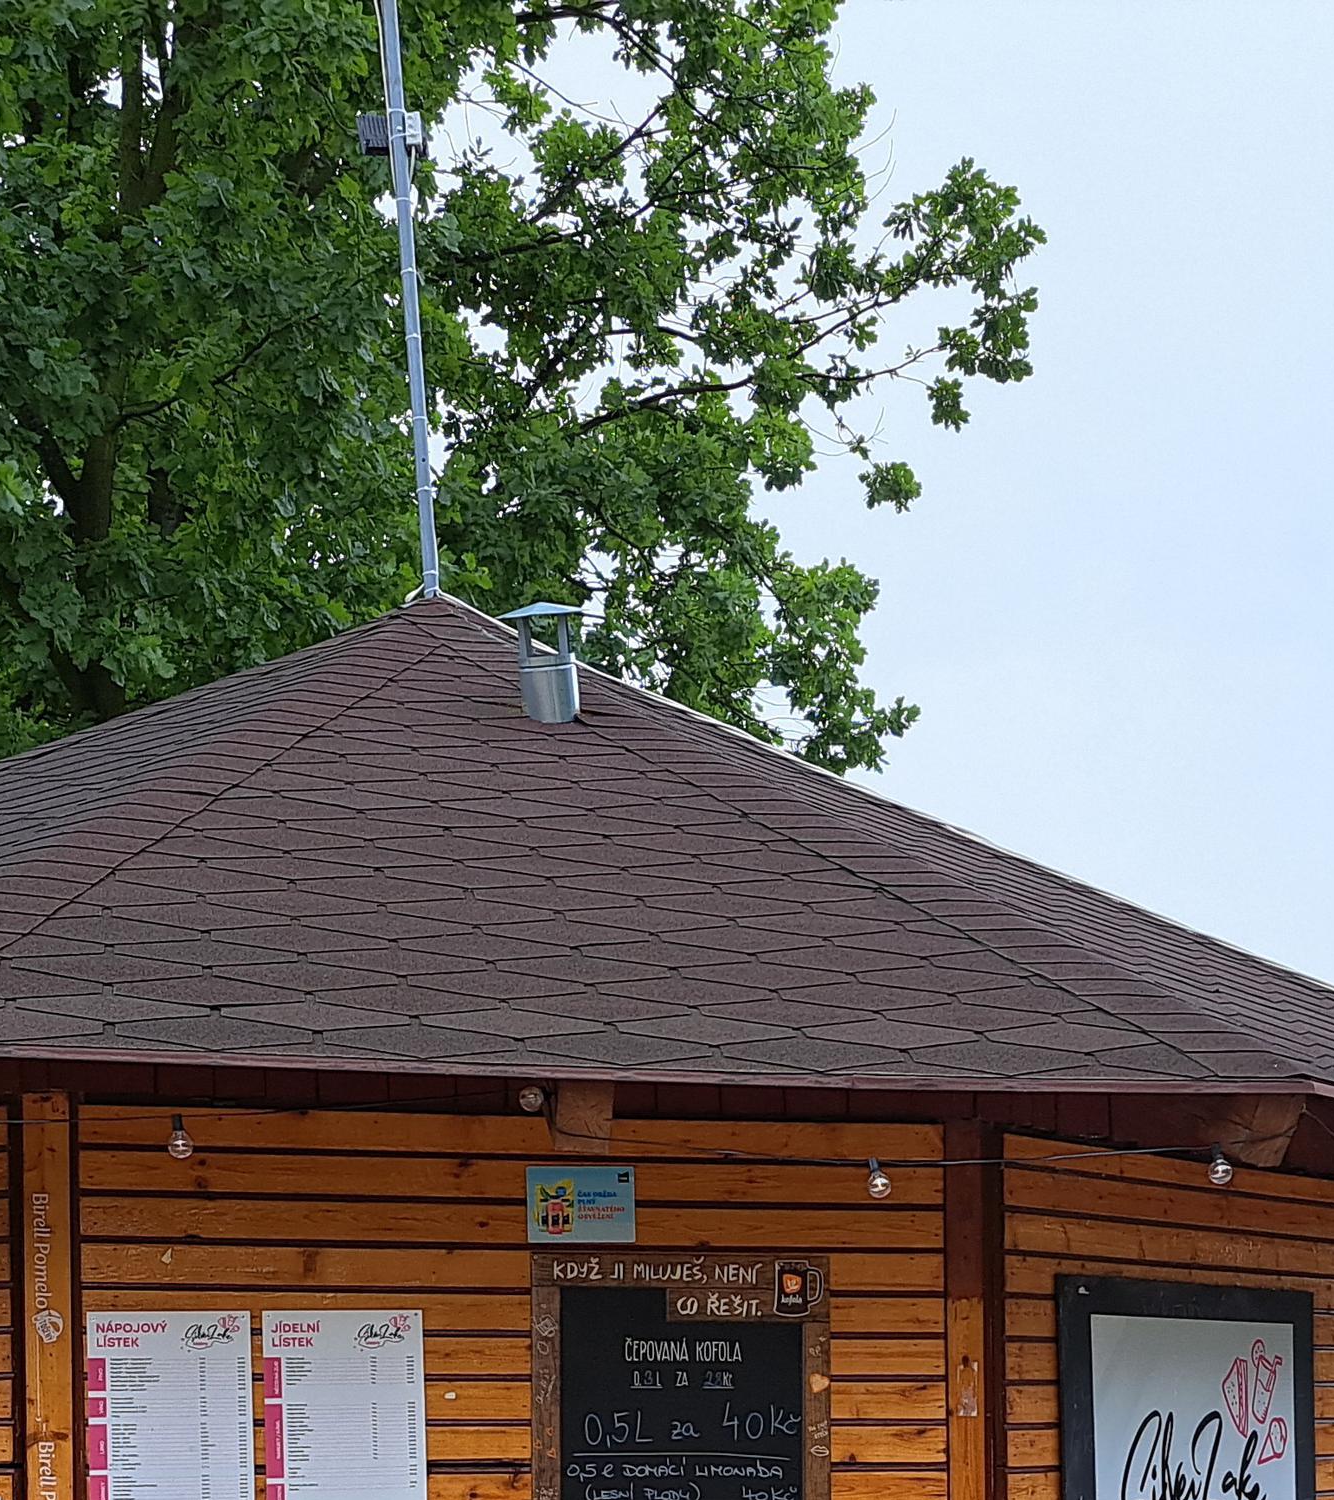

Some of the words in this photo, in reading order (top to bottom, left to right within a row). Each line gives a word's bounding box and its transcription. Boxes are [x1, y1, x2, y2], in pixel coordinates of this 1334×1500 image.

[32, 1193, 52, 1239] Birell
[33, 1243, 53, 1310] Pomelo
[553, 1257, 602, 1281] KDYŽ
[610, 1262, 624, 1280] JI
[633, 1256, 708, 1285] MILUJEŠ,
[715, 1262, 763, 1285] NENÍ
[676, 1296, 698, 1315] CO
[707, 1292, 763, 1317] ŘEŠIT.
[95, 1320, 168, 1334] NÁPOJOVÝ
[271, 1320, 321, 1334] JÍDELNÍ
[96, 1335, 140, 1348] LÍSTEK
[271, 1336, 314, 1348] LÍSTEK
[624, 1337, 689, 1362] ČEPOVANÁ
[696, 1341, 743, 1362] KOFOLA
[675, 1371, 689, 1387] ZA
[670, 1421, 701, 1440] za
[38, 1441, 58, 1488] Birell
[622, 1457, 687, 1478] DOMÁCÍ
